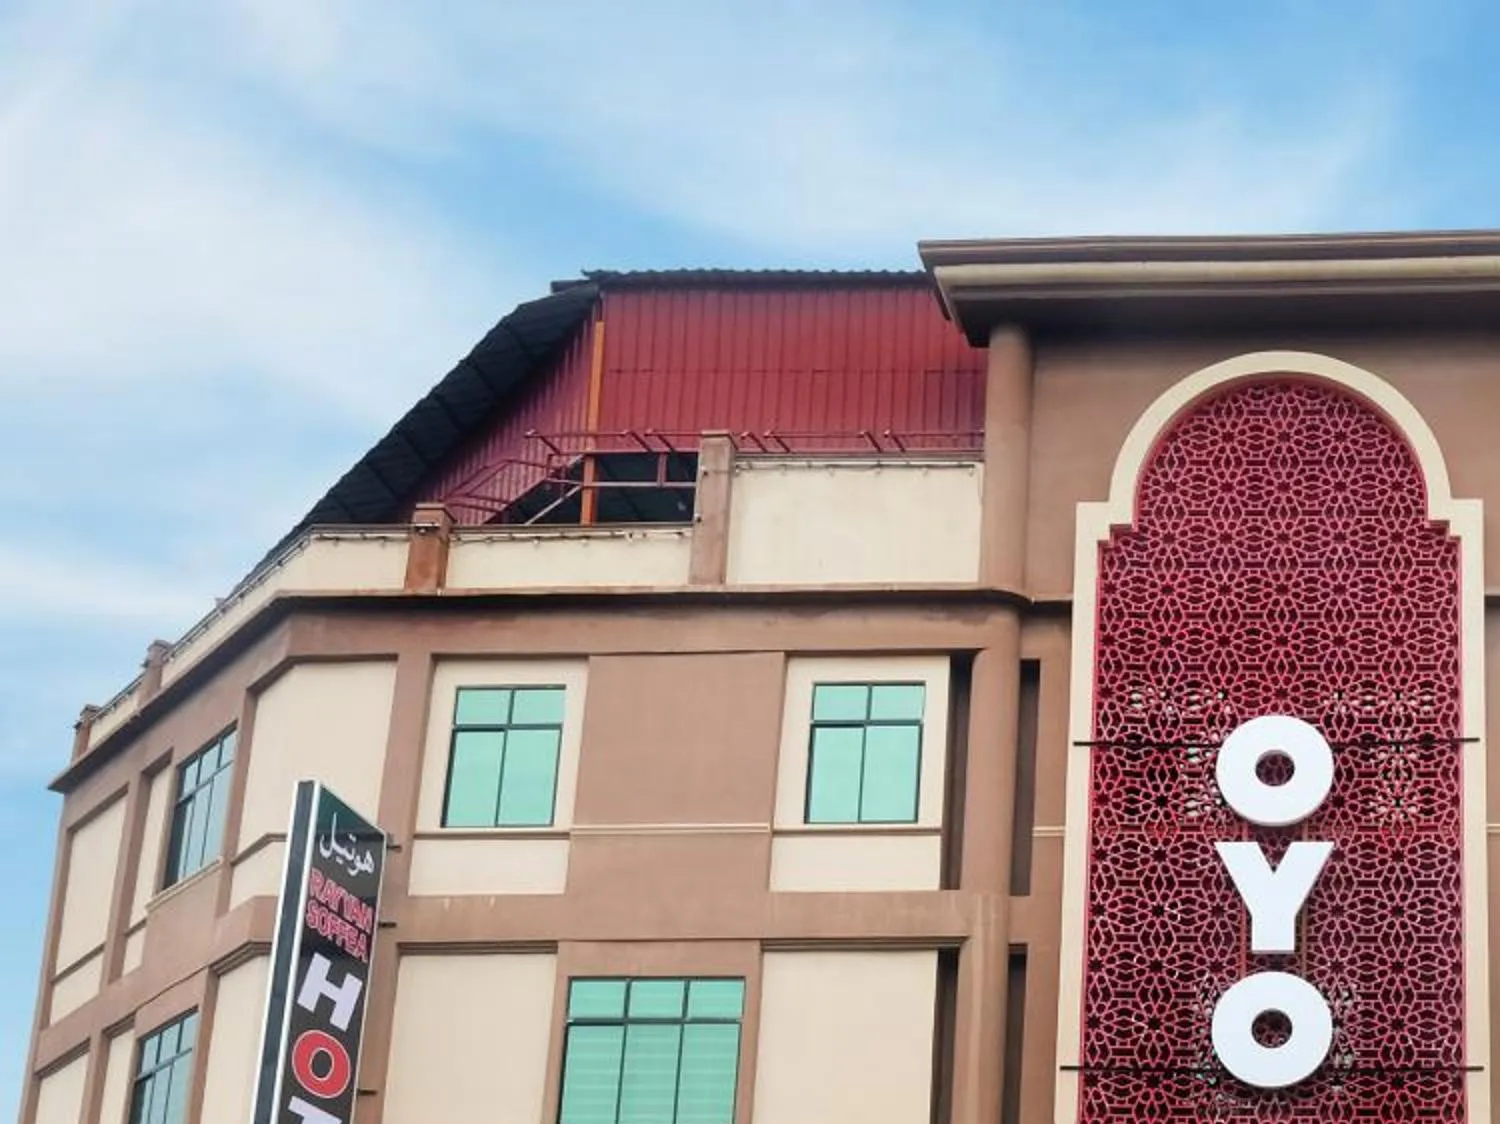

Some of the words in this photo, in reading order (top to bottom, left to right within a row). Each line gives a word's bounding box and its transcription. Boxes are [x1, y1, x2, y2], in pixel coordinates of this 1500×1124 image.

[319, 812, 375, 876] هوتيل
[305, 899, 369, 964] SOFFEA
[310, 867, 374, 935] RAYYAN
[1211, 714, 1335, 1088] OYO
